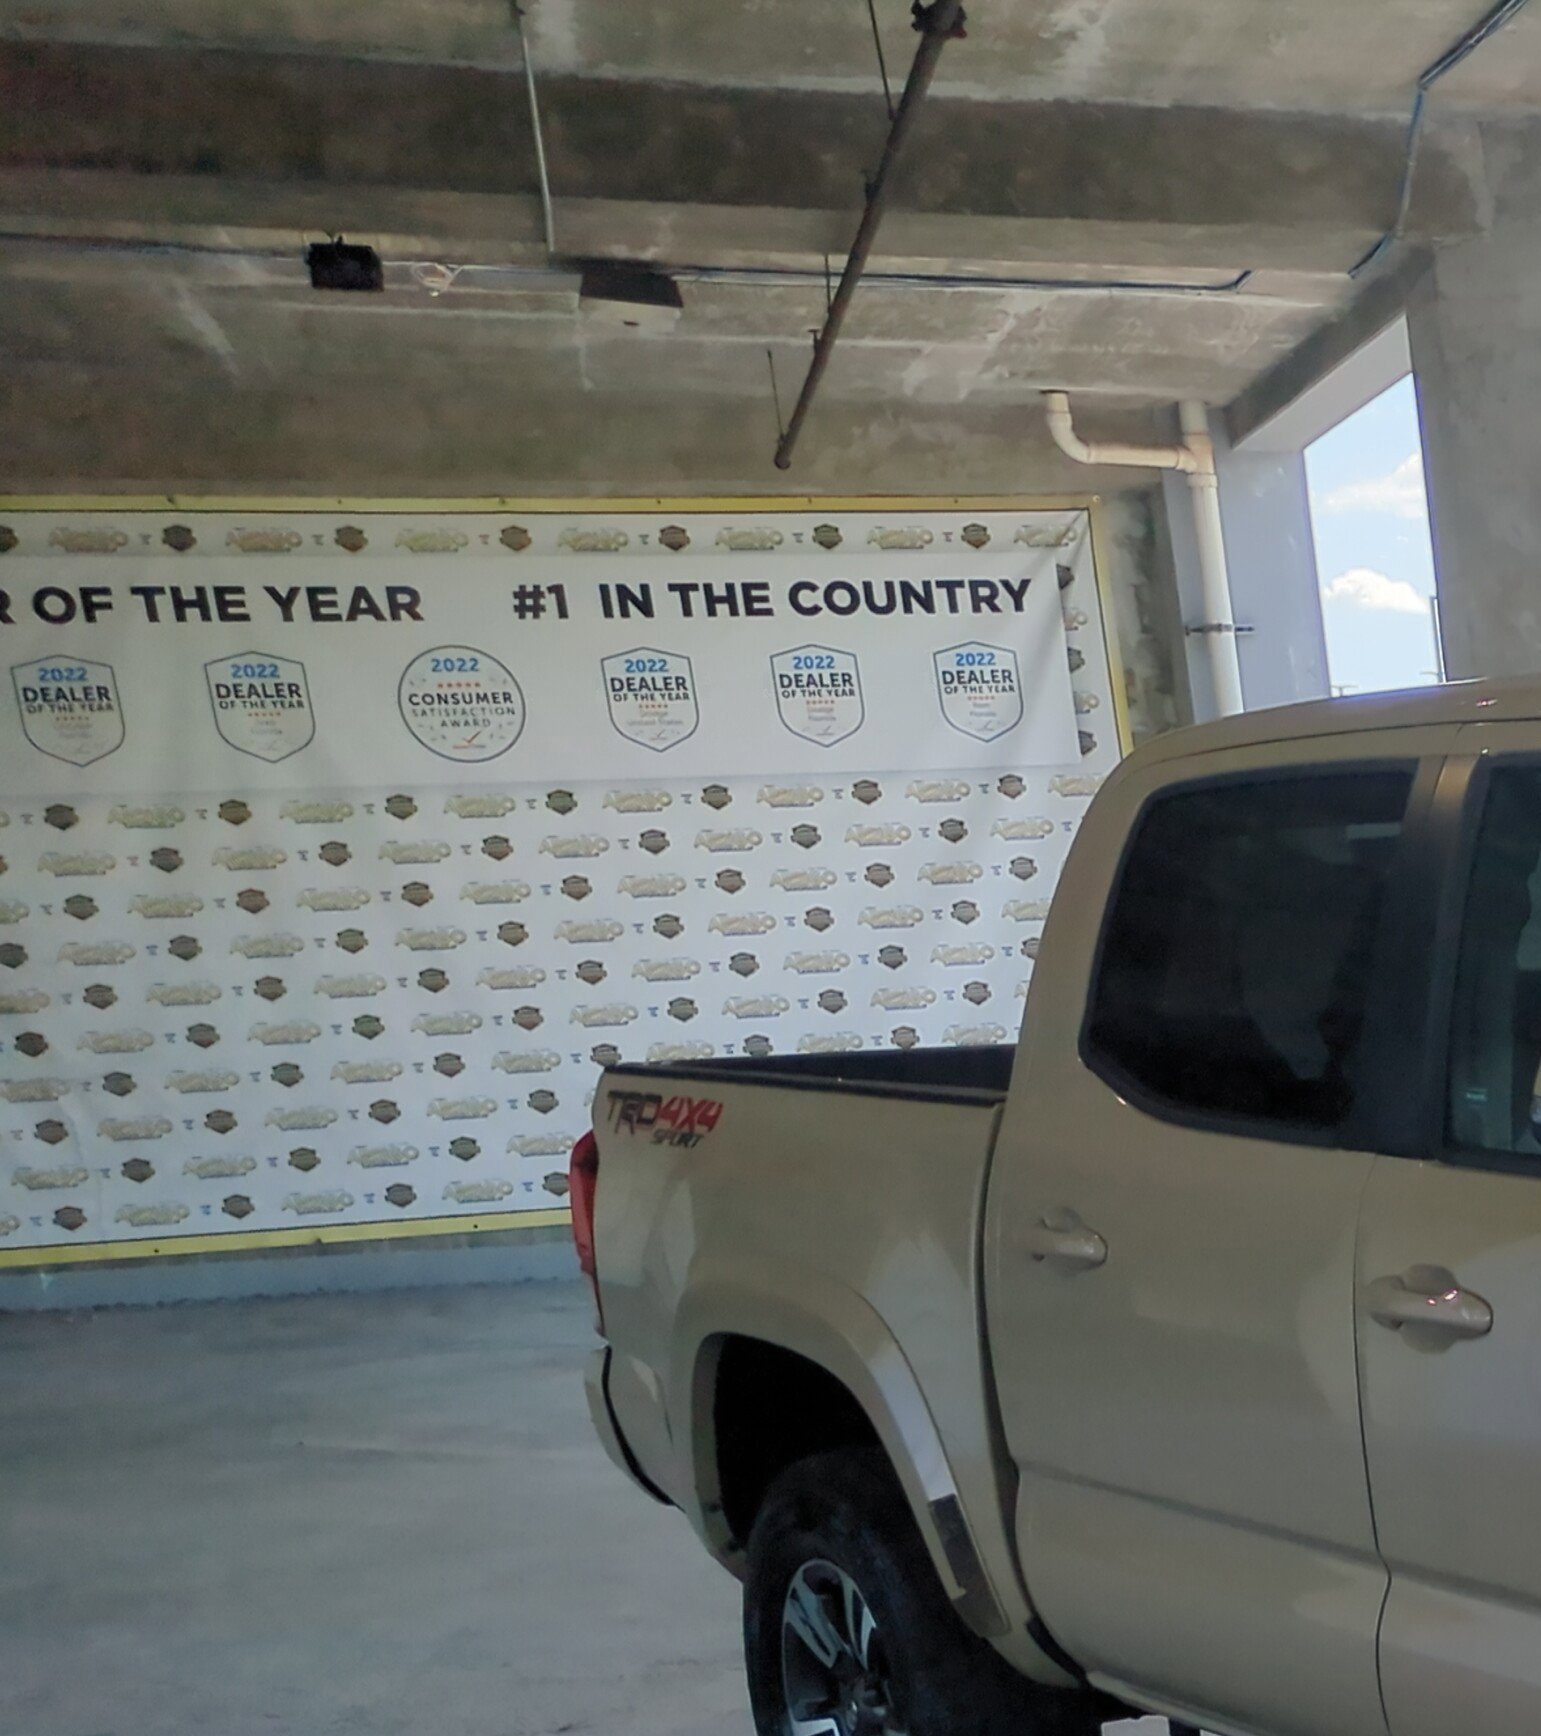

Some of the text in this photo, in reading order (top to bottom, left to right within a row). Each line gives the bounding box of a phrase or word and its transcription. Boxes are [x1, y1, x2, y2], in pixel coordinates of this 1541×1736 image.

[32, 586, 113, 625] OF
[130, 585, 251, 623] THE
[263, 585, 424, 622] YEAR
[512, 578, 1032, 620] #1 IN THE COUNTRY
[431, 658, 480, 672] 2022
[625, 658, 669, 673] 2022
[793, 655, 835, 669] 2022
[956, 652, 996, 667] 2022
[39, 667, 88, 681] 2022
[231, 663, 280, 678] 2022
[942, 669, 1014, 685] DEALER
[610, 676, 688, 692] DEALER
[779, 672, 854, 689] DEALER
[22, 685, 111, 703] DEALER
[215, 682, 302, 699] DEALER
[613, 692, 690, 702] OF THE YEAR
[782, 689, 855, 699] OF THE YEAR
[944, 684, 1015, 695] OF THE YEAR
[219, 700, 304, 710] OF THE YEAR
[408, 692, 513, 706] CONSUMER
[440, 719, 491, 728] AWARD
[607, 1091, 662, 1135] TRD
